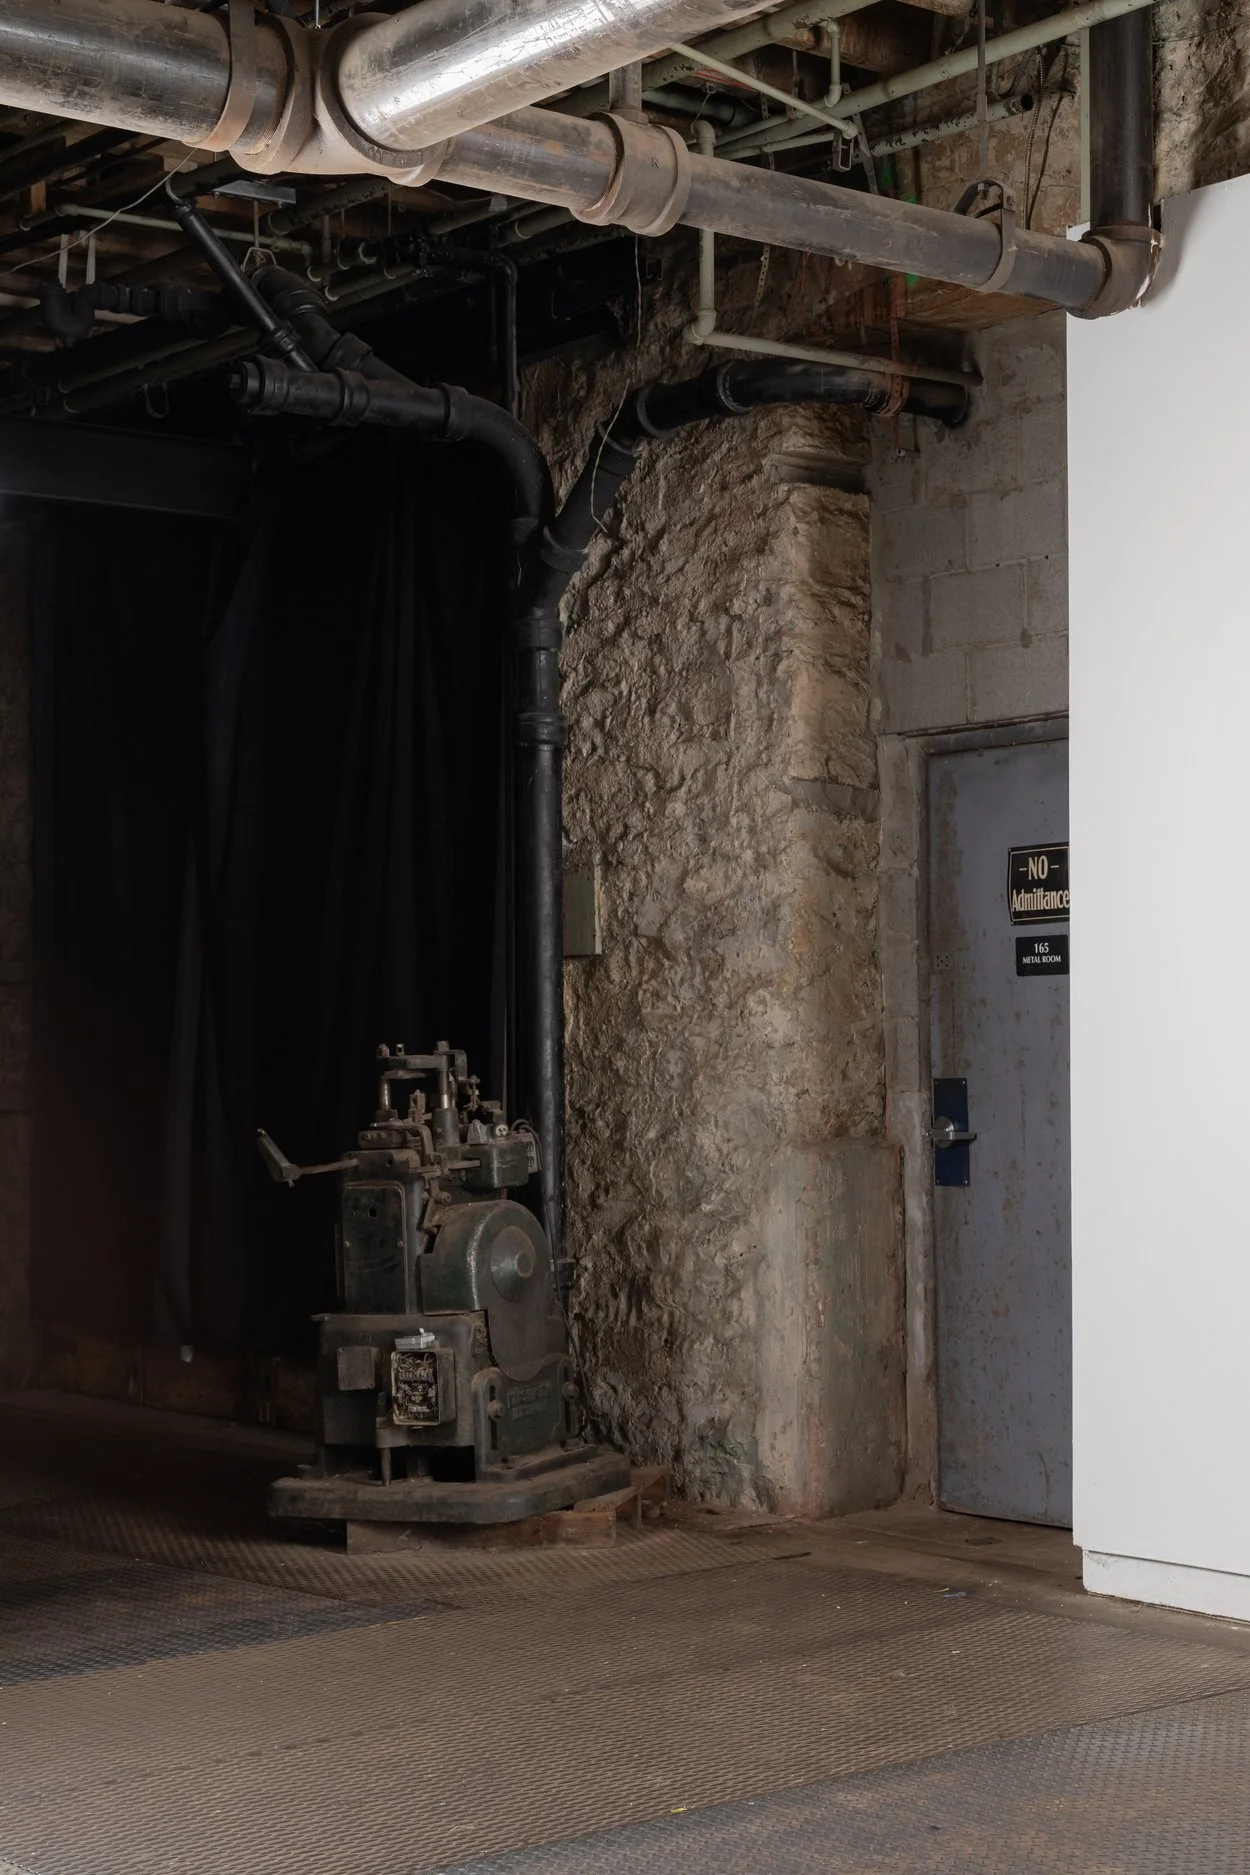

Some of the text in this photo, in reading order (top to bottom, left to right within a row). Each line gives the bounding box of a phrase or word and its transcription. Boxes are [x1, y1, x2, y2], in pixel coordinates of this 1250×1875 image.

[1012, 888, 1070, 912] Admittance
[1034, 943, 1049, 954] 165
[1022, 955, 1062, 964] METAL ROOM
